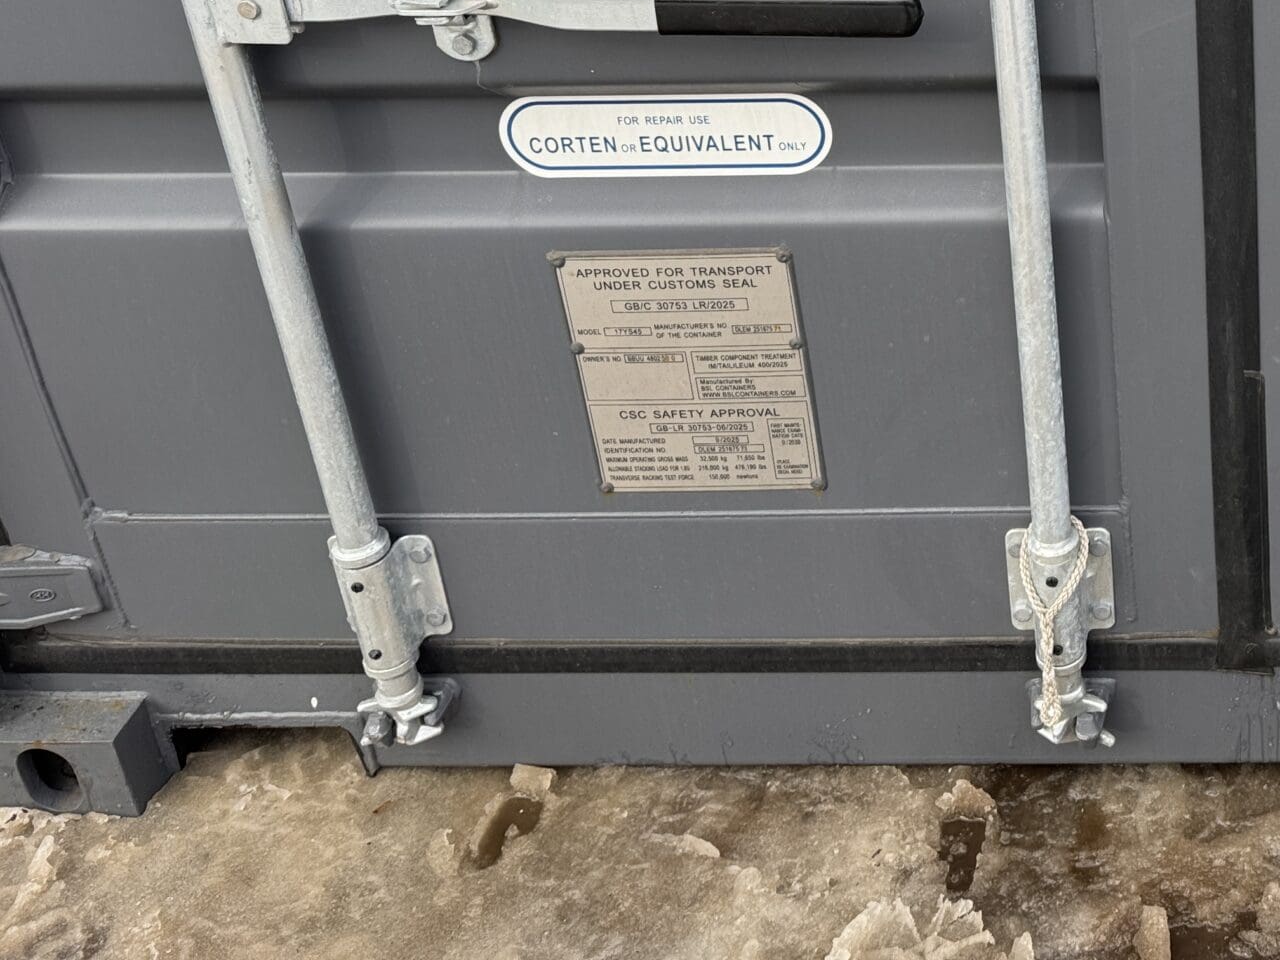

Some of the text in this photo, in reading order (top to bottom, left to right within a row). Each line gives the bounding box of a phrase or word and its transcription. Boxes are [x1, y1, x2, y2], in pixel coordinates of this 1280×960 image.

[617, 115, 711, 125] FOR REPAIR USE
[529, 134, 807, 154] CORTEN OR EQUIVALENT ONLY
[576, 266, 772, 278] APPROVED FOR TRANSPORT
[594, 279, 758, 290] UNDER CUSTOMS SEAL
[625, 301, 735, 311] GB/C 30753 LR/2025
[619, 408, 780, 419] CSC SAFETY APPROVAL
